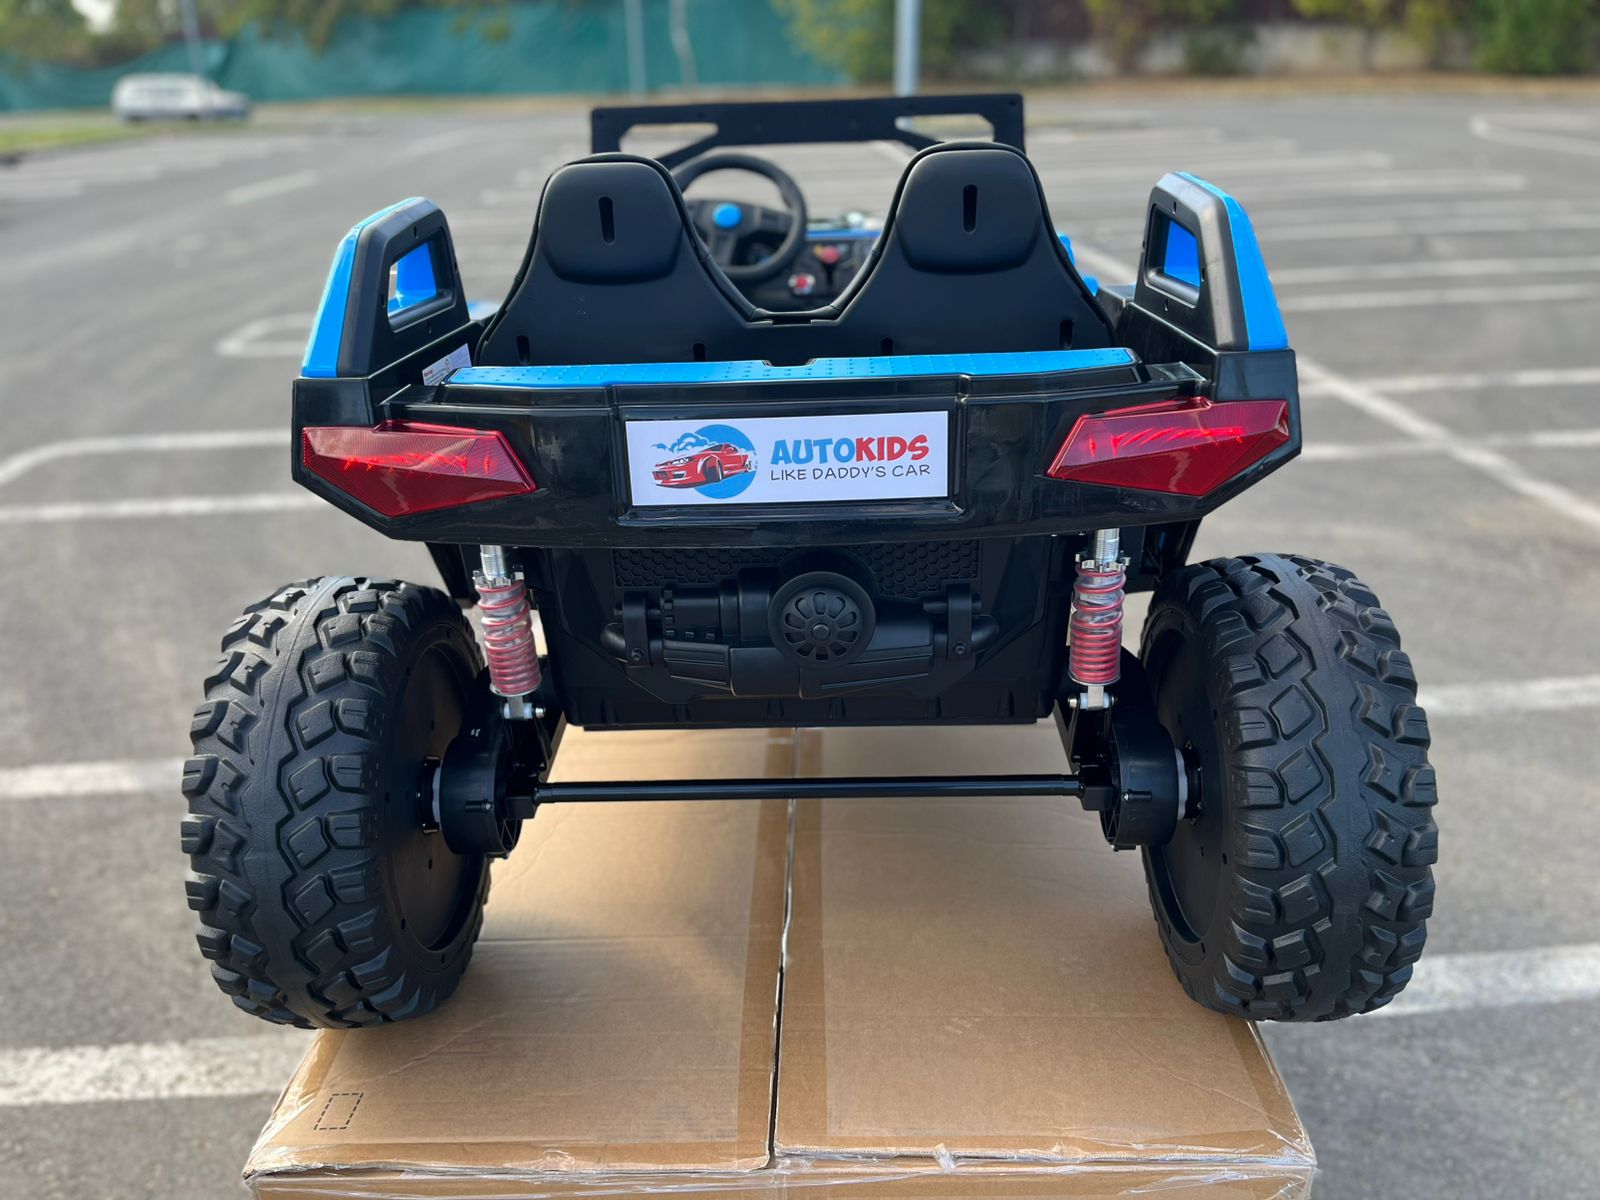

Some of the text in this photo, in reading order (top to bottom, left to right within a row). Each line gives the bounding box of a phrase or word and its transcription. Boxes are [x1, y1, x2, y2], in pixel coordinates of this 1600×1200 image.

[770, 434, 930, 465] AUTOKIDS
[771, 464, 931, 481] LIKE DADDY'S CAR
